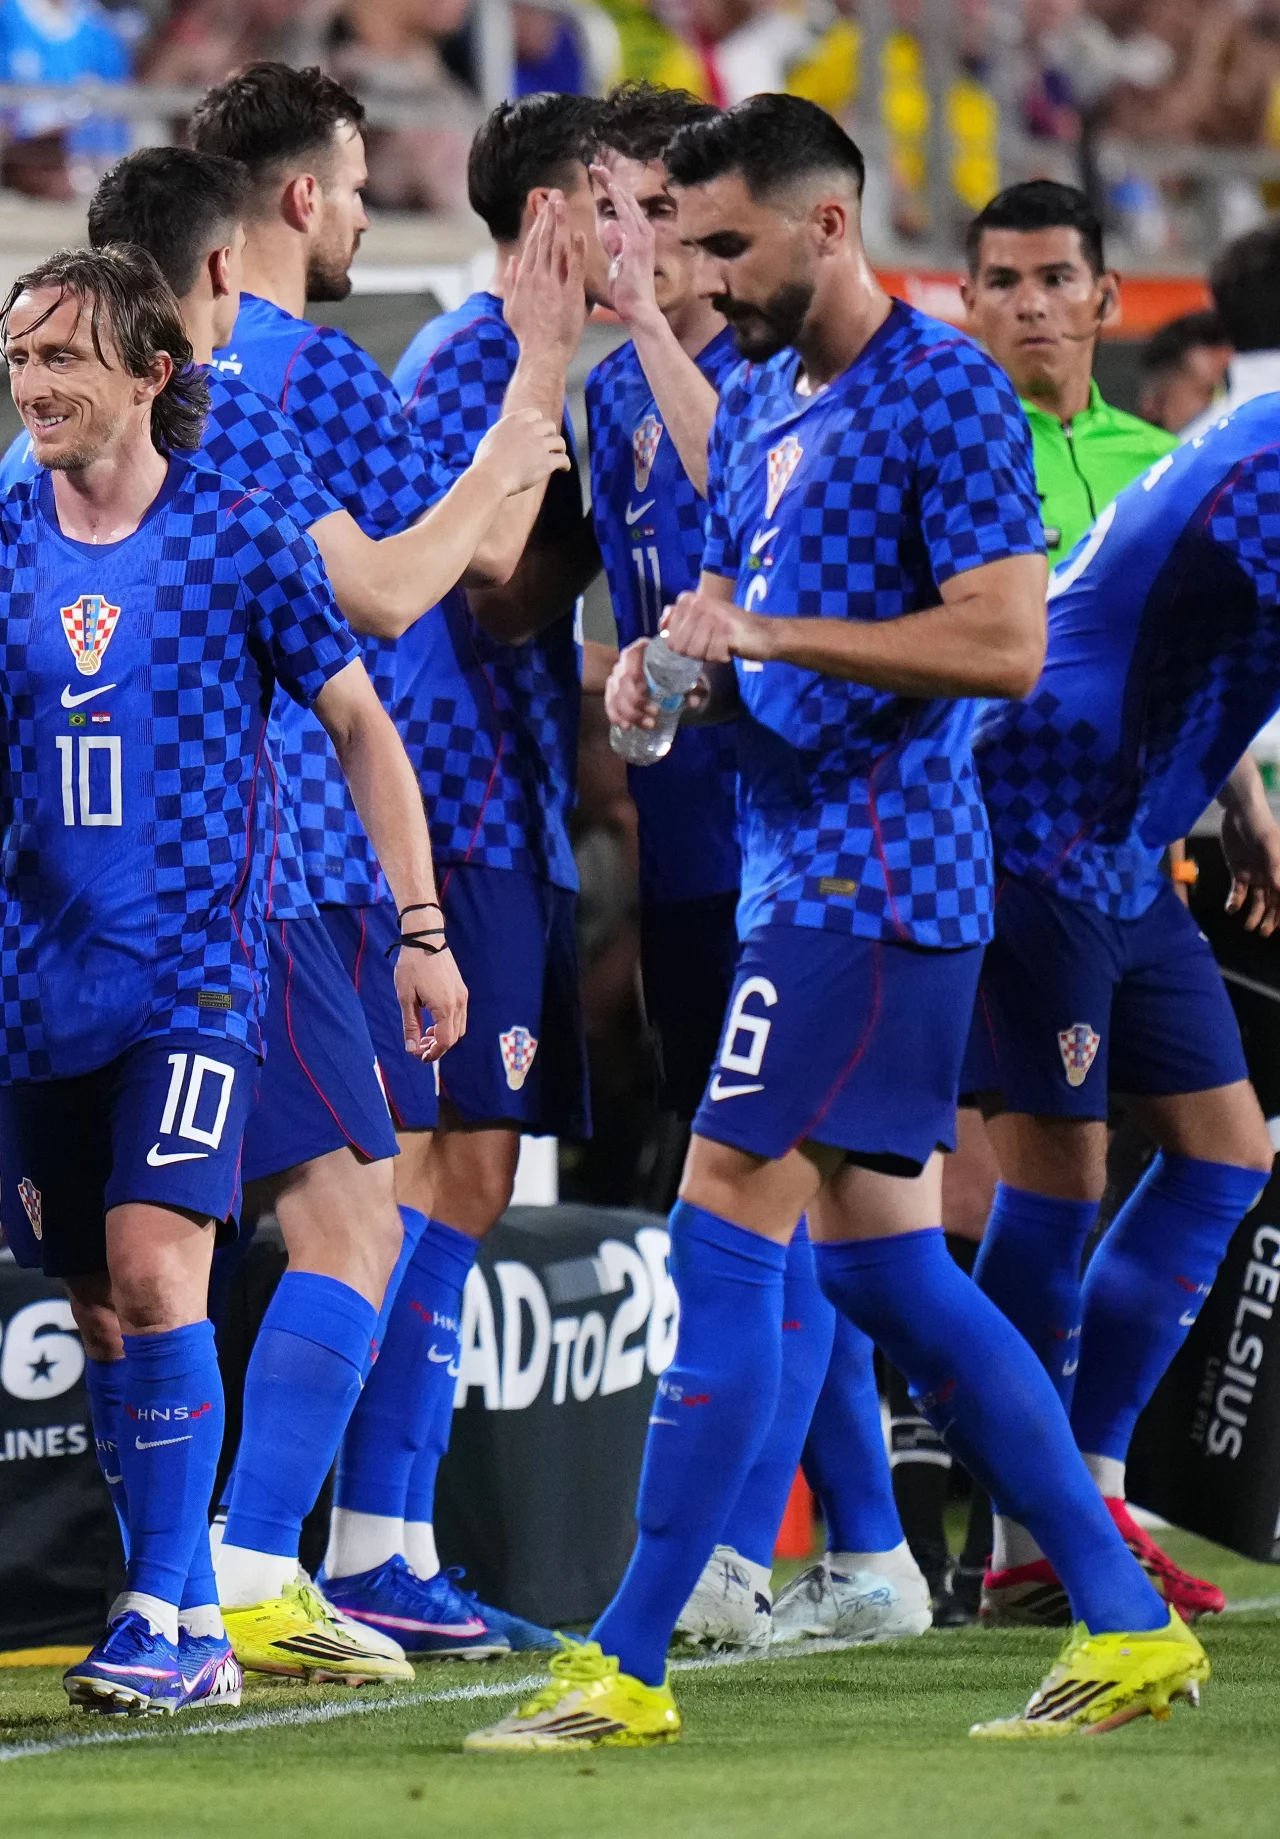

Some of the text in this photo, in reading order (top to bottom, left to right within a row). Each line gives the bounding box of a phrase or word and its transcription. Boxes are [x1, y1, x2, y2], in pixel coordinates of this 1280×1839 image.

[631, 546, 662, 634] 11
[55, 735, 122, 826] 10
[720, 976, 778, 1076] 6
[159, 1053, 235, 1150] 10
[1207, 1224, 1280, 1460] CELSIUS
[138, 1406, 189, 1421] HNS
